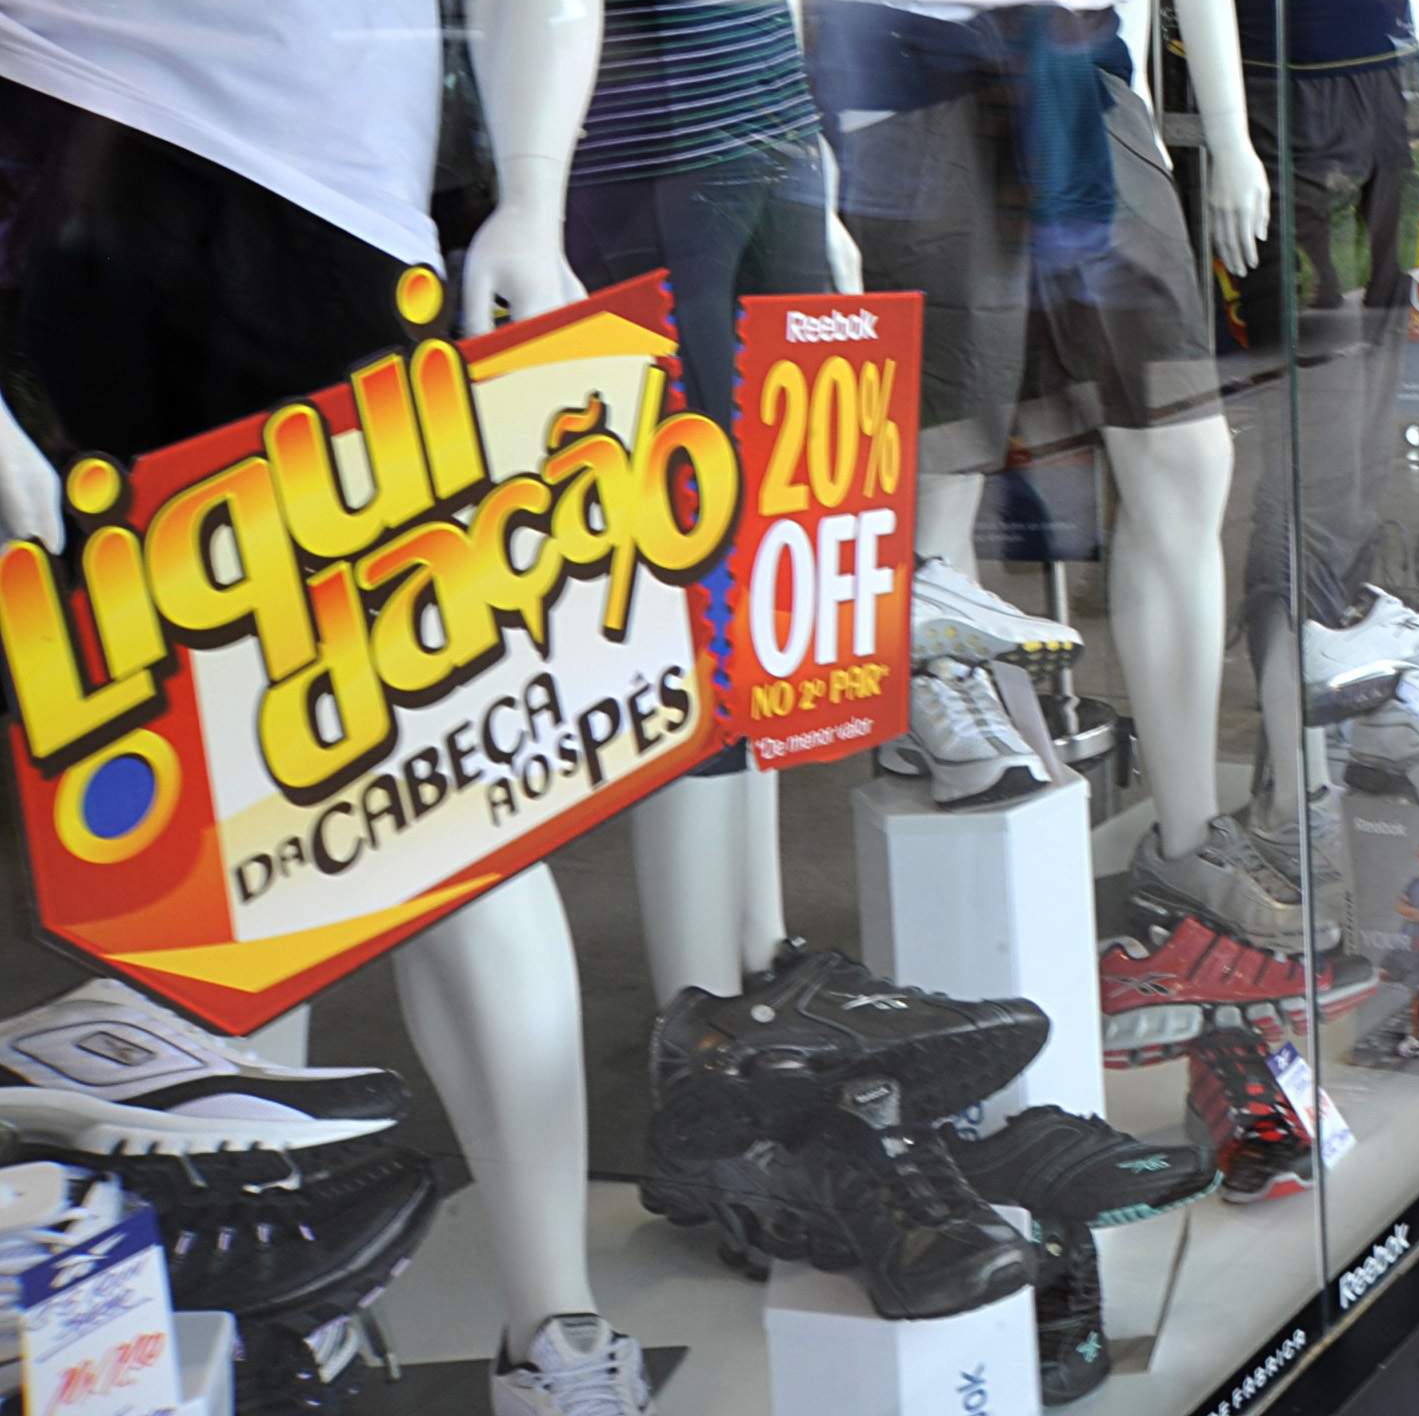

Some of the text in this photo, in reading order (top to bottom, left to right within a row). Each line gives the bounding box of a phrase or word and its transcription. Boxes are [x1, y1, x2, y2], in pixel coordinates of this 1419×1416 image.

[786, 309, 879, 344] Reebok
[759, 355, 902, 517] 20%
[0, 266, 485, 764] Liqui
[749, 507, 898, 678] OFF
[751, 680, 796, 721] NO
[835, 715, 874, 740] valor
[310, 671, 565, 876] CABEÇA
[1339, 1222, 1411, 1310] Reebok
